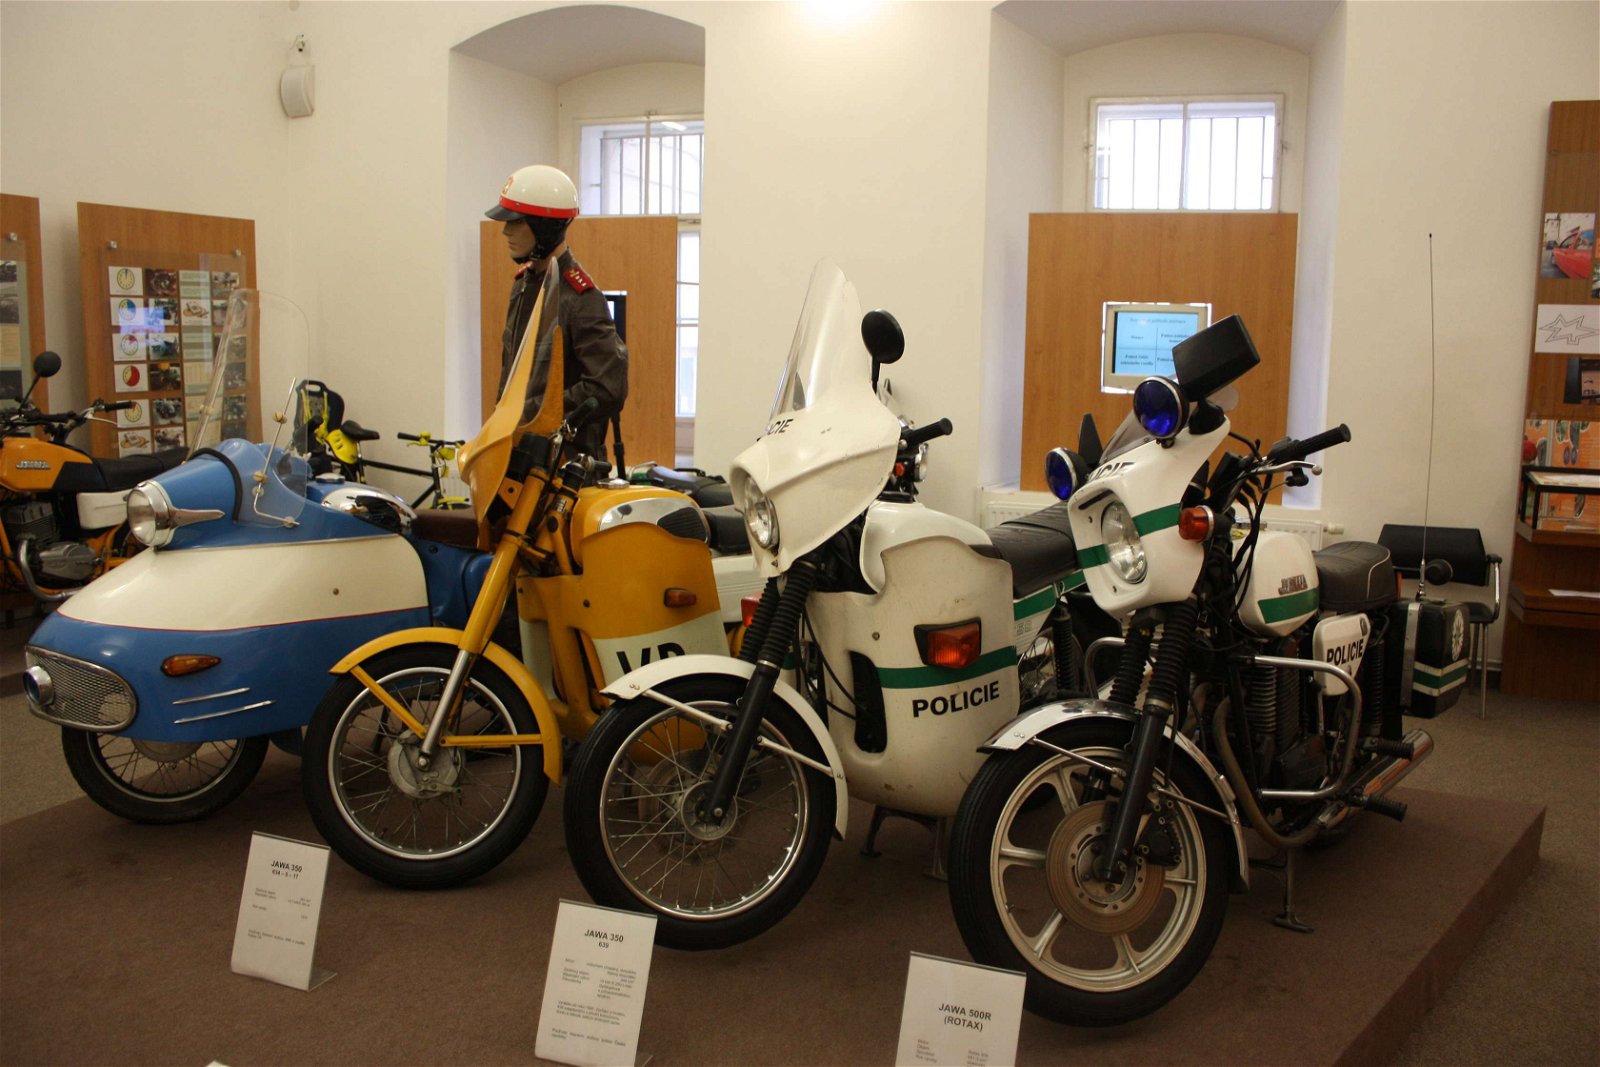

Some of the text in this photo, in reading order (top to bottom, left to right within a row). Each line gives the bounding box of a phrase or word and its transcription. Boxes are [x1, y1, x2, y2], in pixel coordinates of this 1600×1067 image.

[1326, 638, 1365, 666] POLICIE
[912, 680, 1000, 718] POLICIE
[270, 860, 303, 873] JAWA 350
[584, 929, 624, 943] JAWA 350
[598, 941, 610, 949] 639
[938, 1003, 992, 1021] JAWA 500R
[944, 1015, 984, 1033] (ROTAX)
